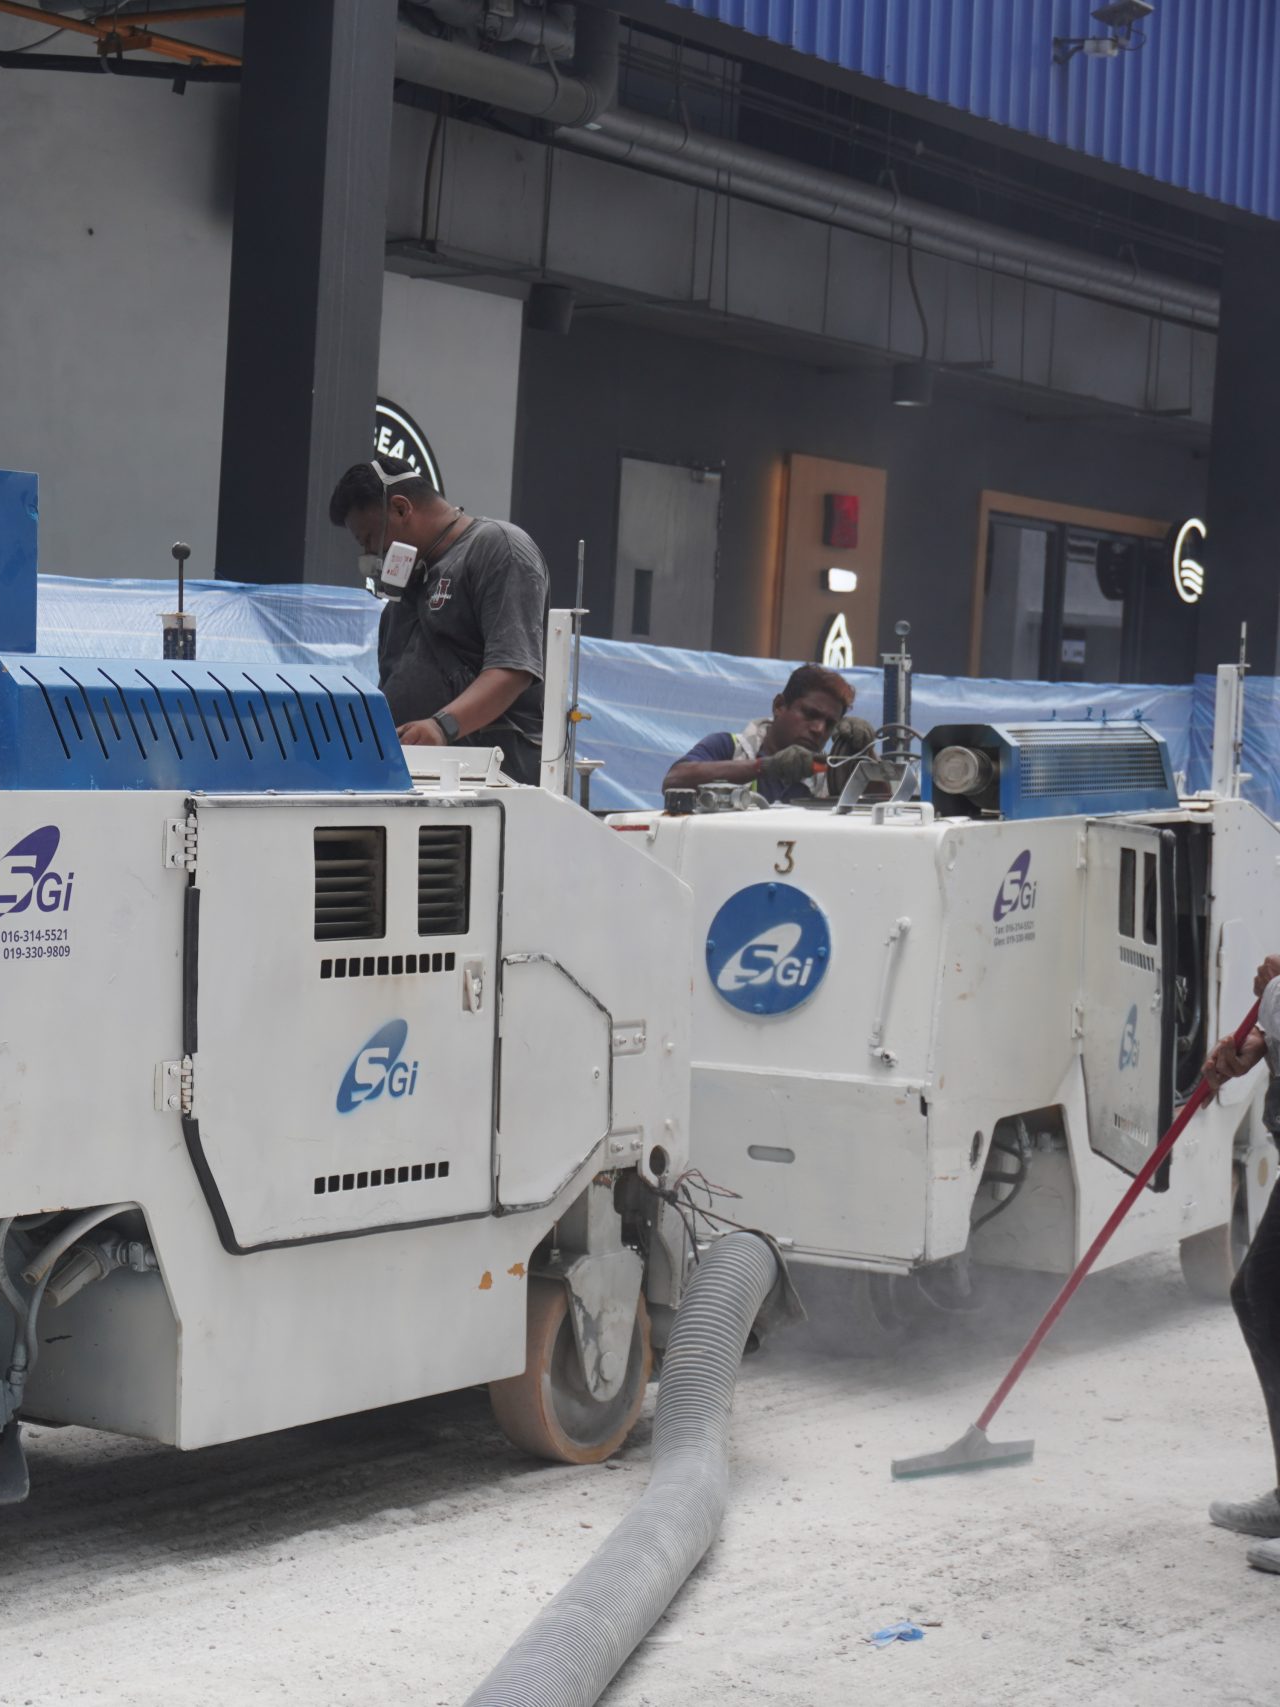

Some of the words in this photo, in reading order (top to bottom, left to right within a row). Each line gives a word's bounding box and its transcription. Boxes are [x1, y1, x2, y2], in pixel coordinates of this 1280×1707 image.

[774, 840, 797, 875] 3
[1, 928, 69, 943] 016-314-5521
[3, 945, 71, 960] 019-330-9809
